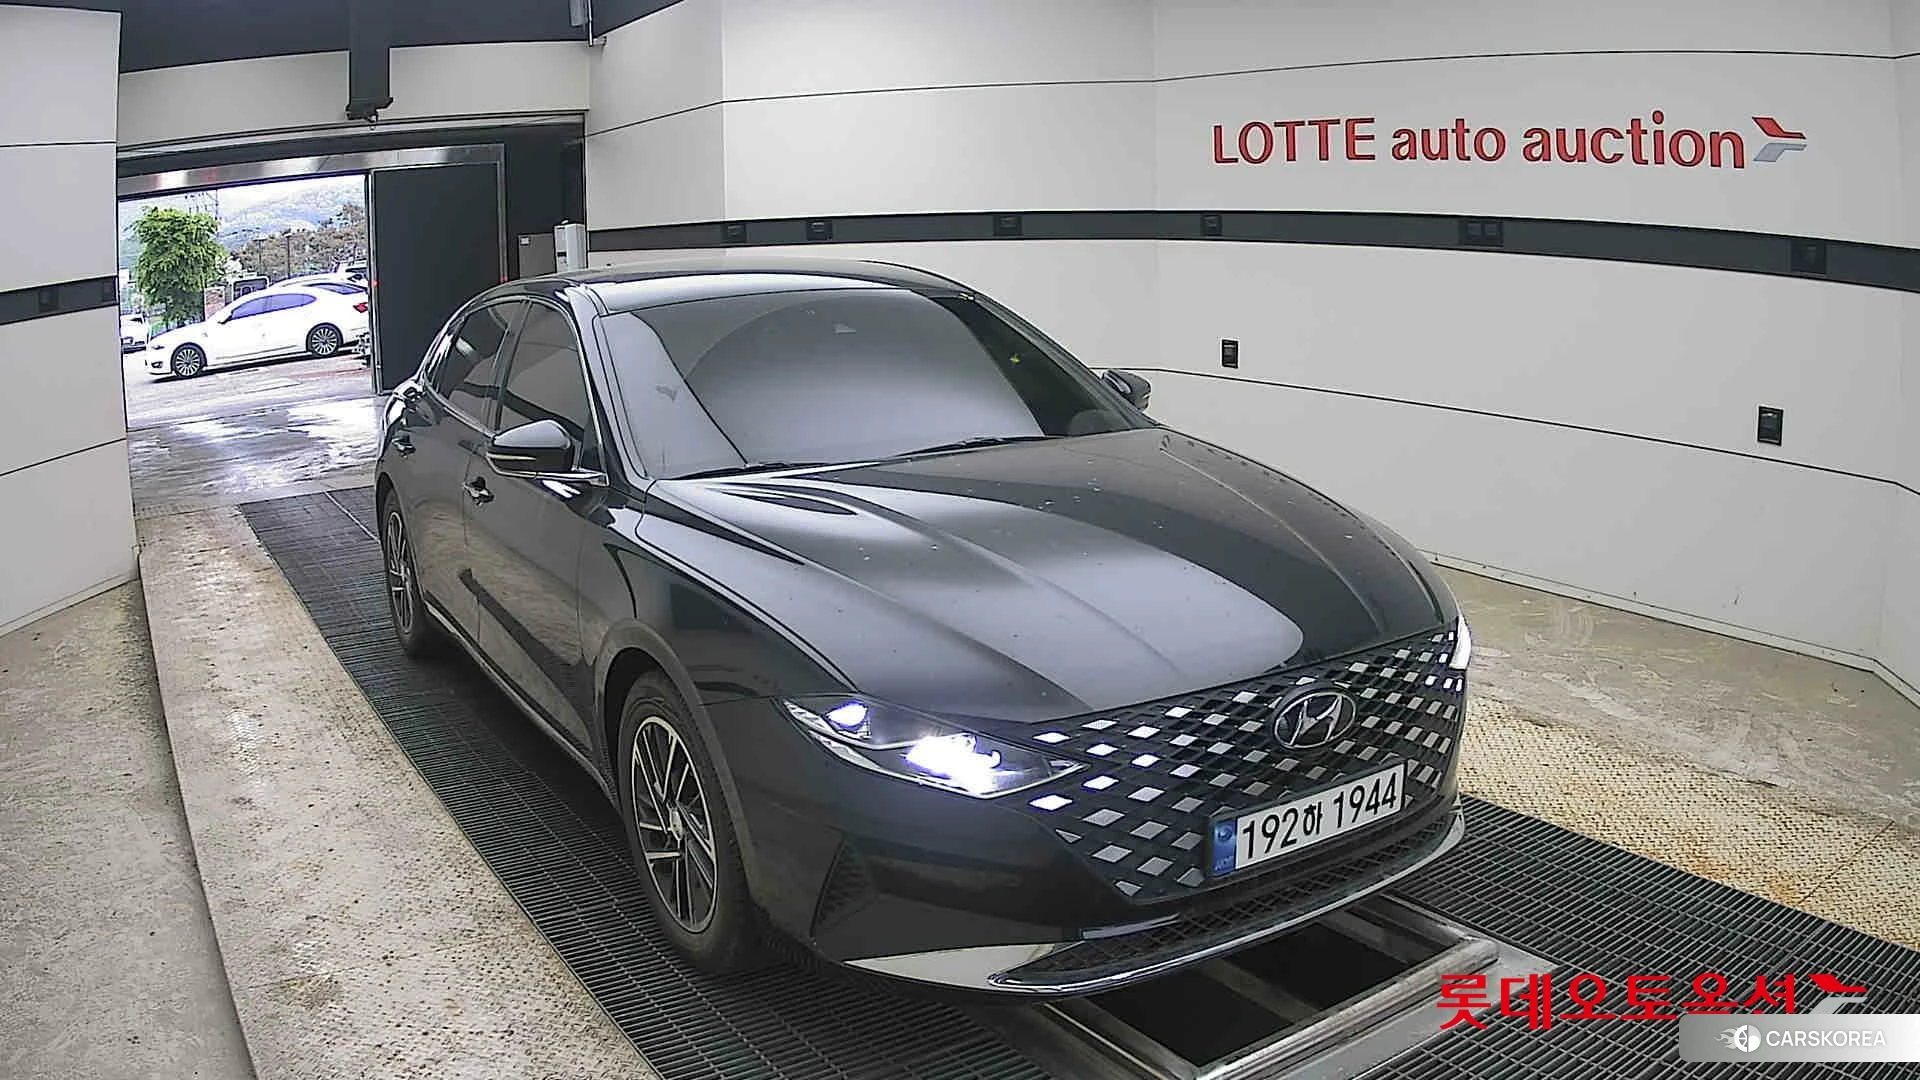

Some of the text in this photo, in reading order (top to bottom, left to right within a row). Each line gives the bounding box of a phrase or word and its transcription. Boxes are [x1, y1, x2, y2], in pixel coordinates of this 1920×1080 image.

[1212, 110, 1746, 170] LOTTE auto auction
[1242, 772, 1397, 859] 192하 1944
